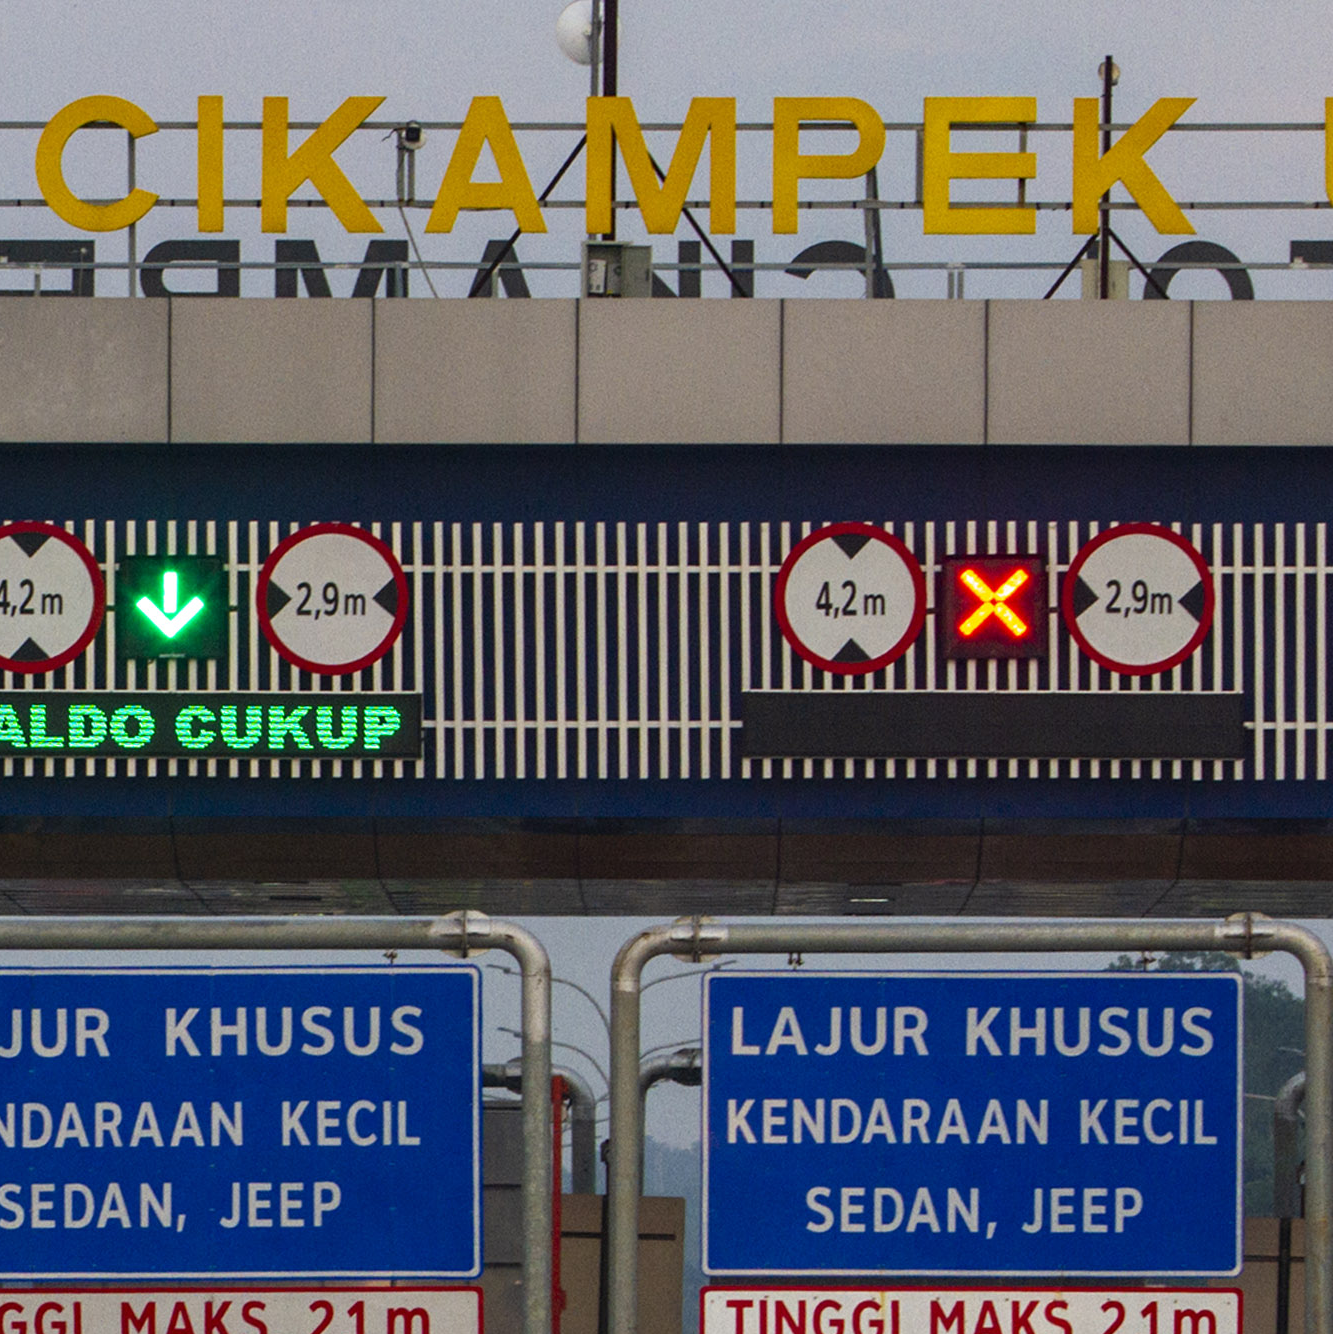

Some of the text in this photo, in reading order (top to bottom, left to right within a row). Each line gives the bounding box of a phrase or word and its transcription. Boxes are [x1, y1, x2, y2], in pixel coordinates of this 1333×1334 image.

[36, 95, 1196, 234] CIKAMPEK
[175, 705, 401, 750] CUKUP
[166, 1005, 424, 1056] KHUSUS
[732, 1006, 1213, 1057] LAJUR KHUSUS
[282, 1100, 420, 1146] KECIL
[727, 1098, 1217, 1145] KENDARAAN KECIL
[220, 1181, 341, 1228] JEEP
[806, 1186, 1143, 1239] SEDAN, JEEP
